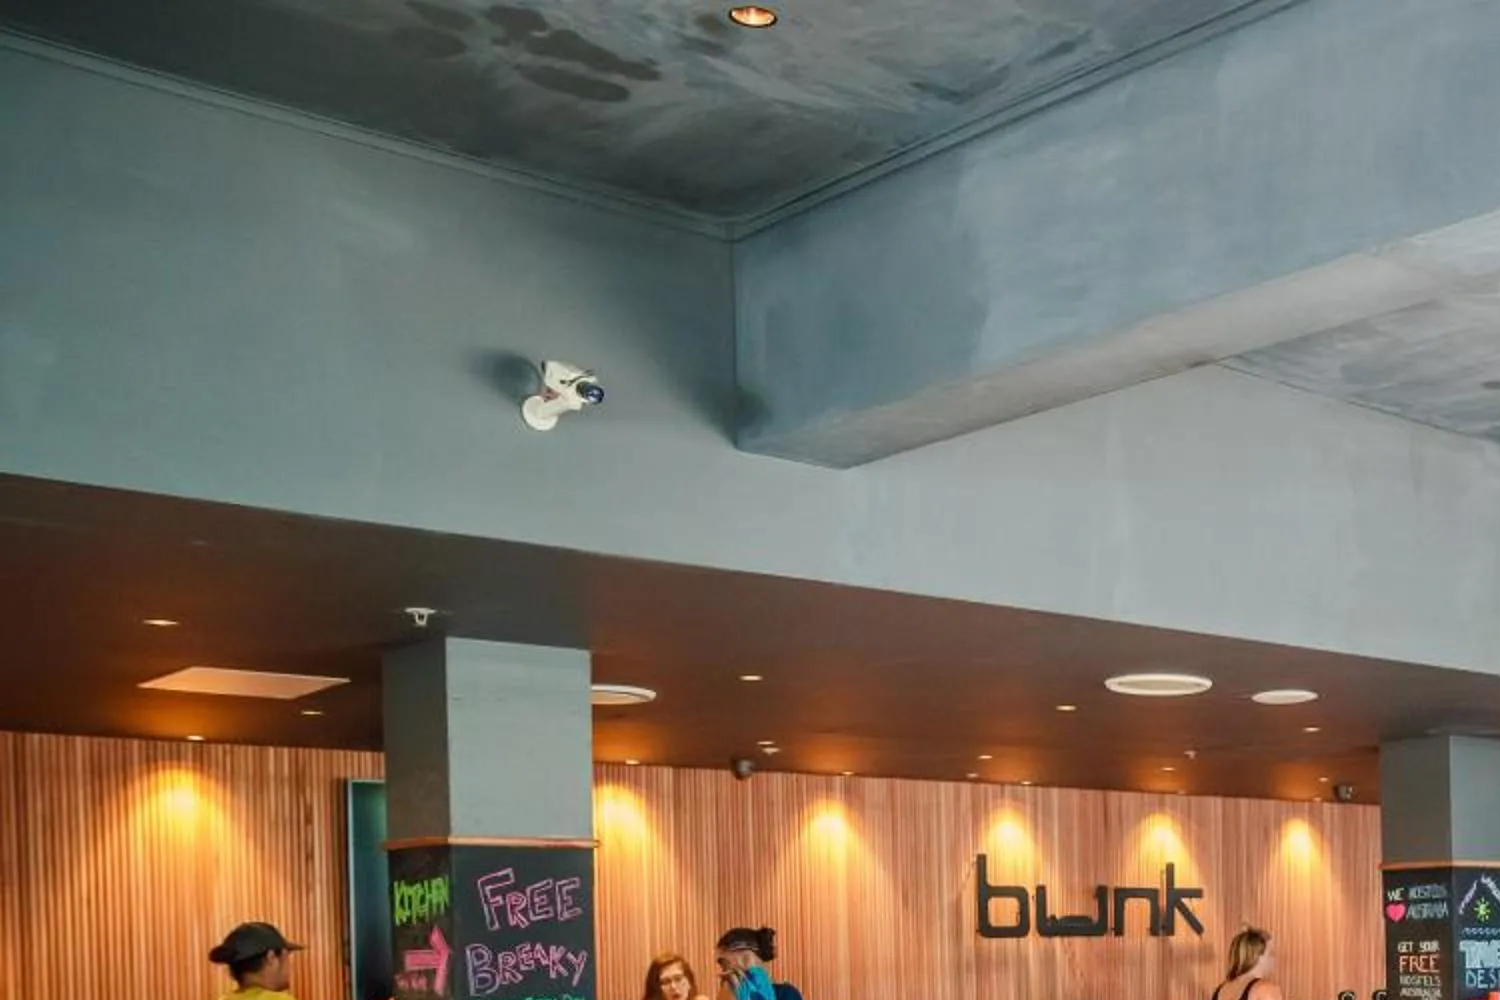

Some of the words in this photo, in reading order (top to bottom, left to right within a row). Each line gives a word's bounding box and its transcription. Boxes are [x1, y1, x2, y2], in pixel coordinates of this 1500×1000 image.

[477, 867, 583, 931] FREE
[466, 942, 589, 997] BREAKY
[1399, 954, 1441, 973] FREE
